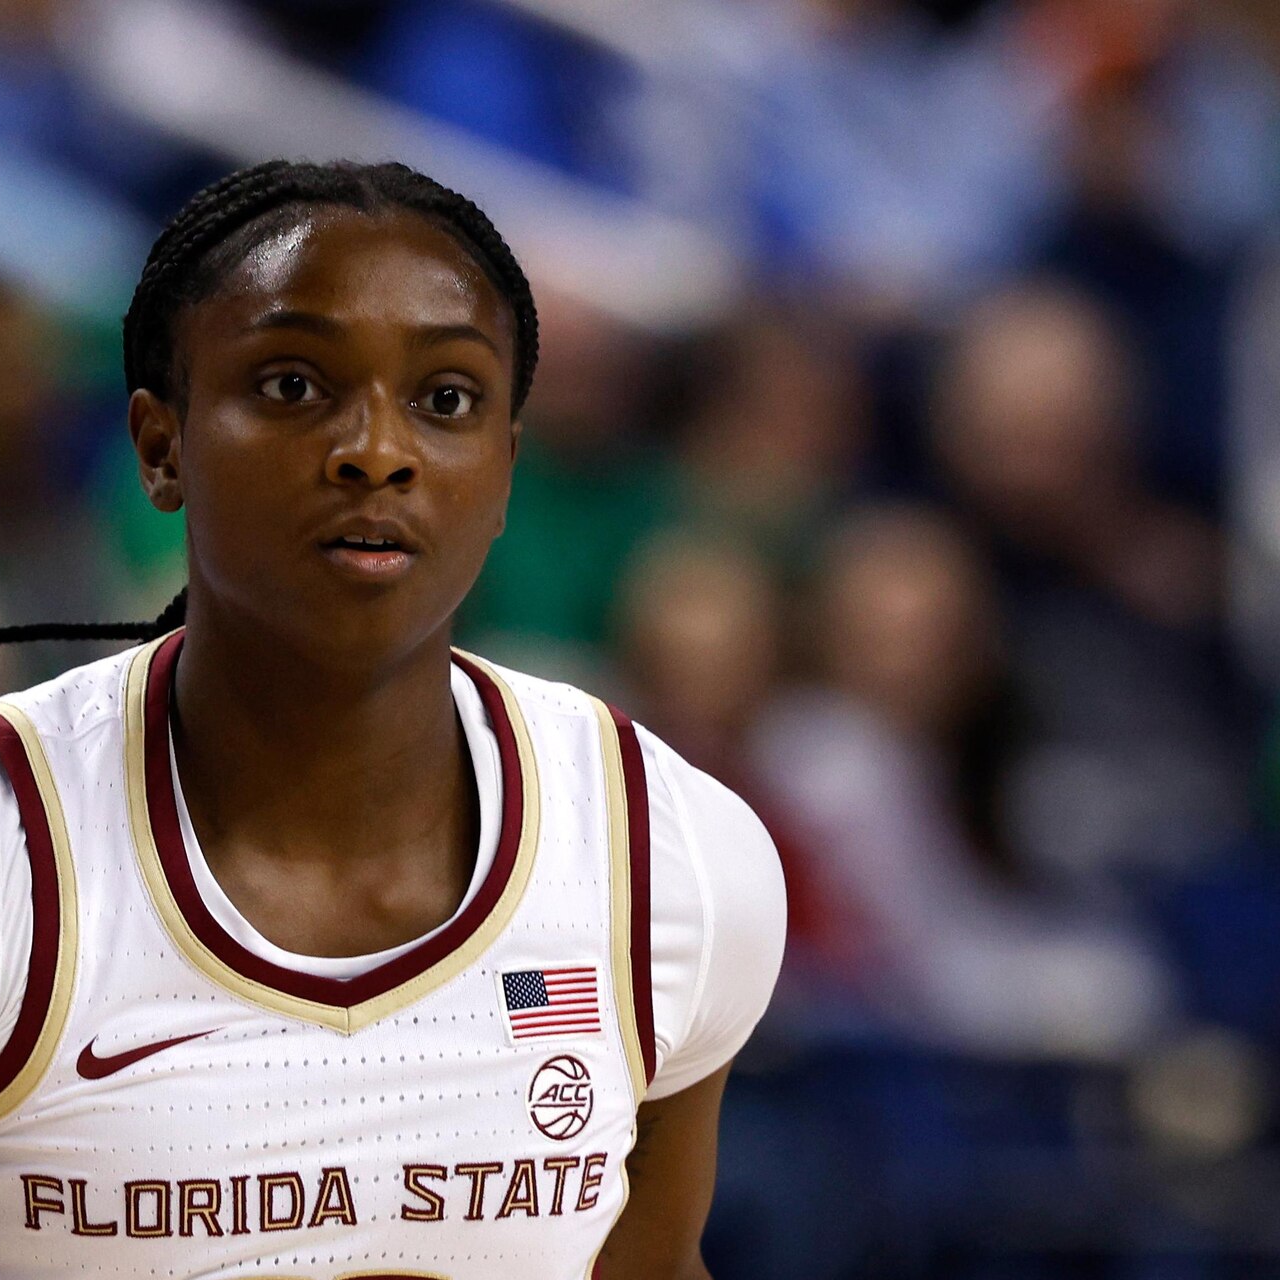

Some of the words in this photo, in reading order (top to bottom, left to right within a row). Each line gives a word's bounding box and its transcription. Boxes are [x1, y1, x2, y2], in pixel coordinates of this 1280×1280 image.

[538, 1083, 592, 1102] ACC
[20, 1166, 357, 1238] FLORIDA
[402, 1153, 608, 1223] STATE
